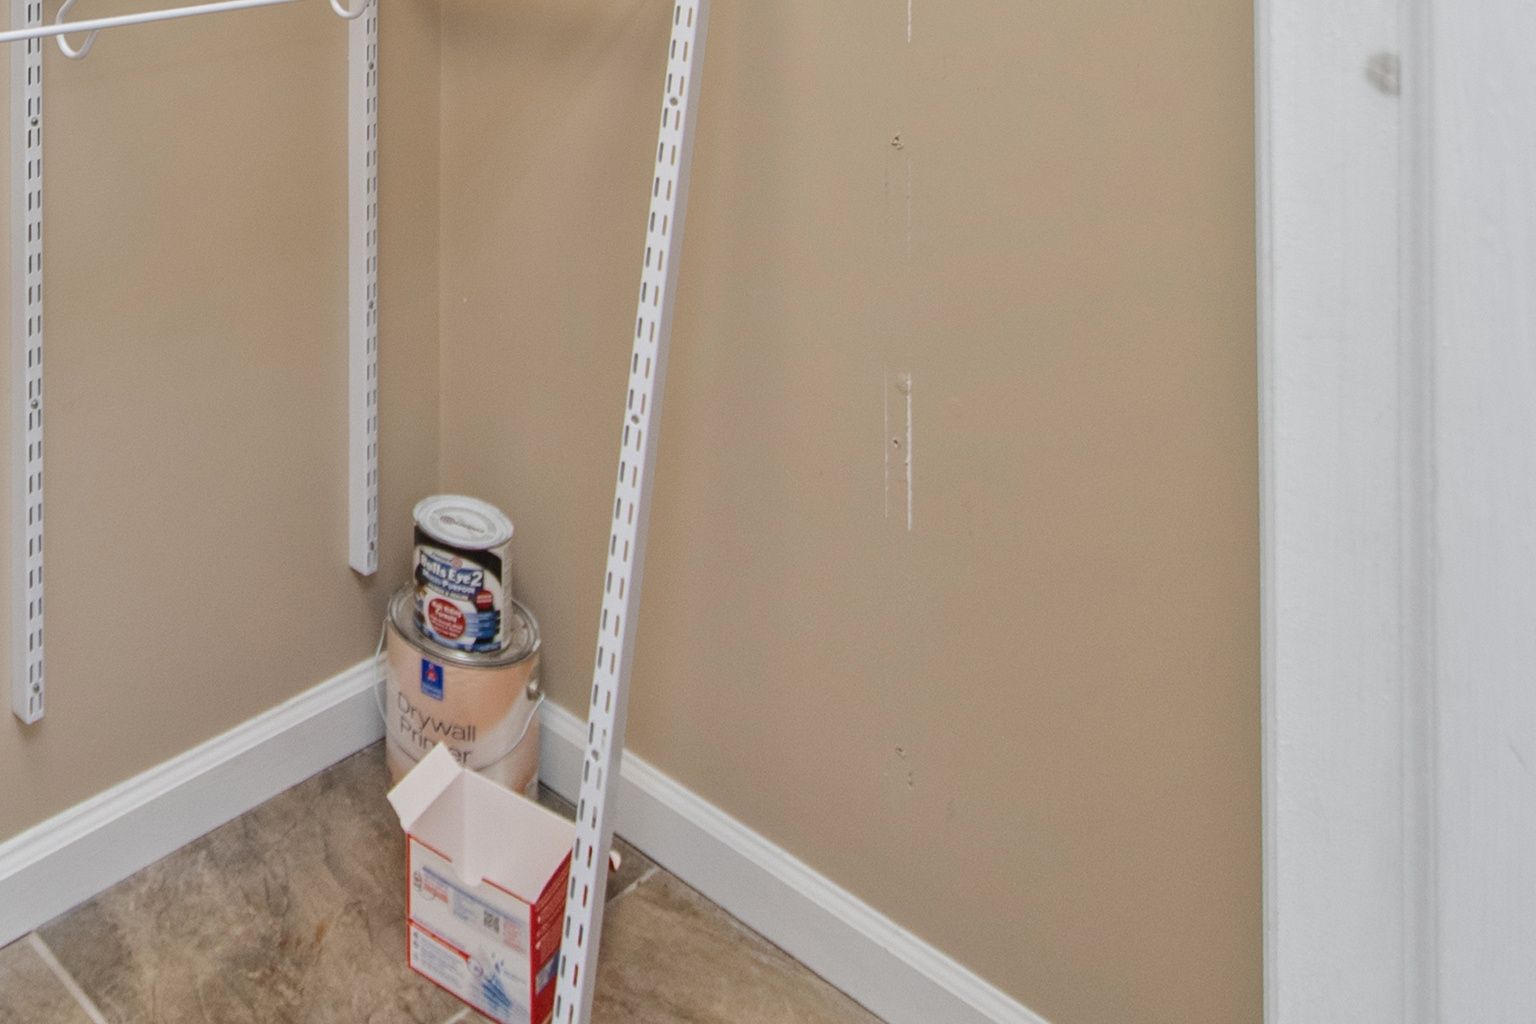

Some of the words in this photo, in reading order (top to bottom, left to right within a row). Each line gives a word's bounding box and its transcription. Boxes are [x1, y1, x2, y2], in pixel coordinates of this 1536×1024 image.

[448, 568, 472, 585] Eye
[470, 570, 483, 587] 2
[397, 690, 476, 743] Drywall
